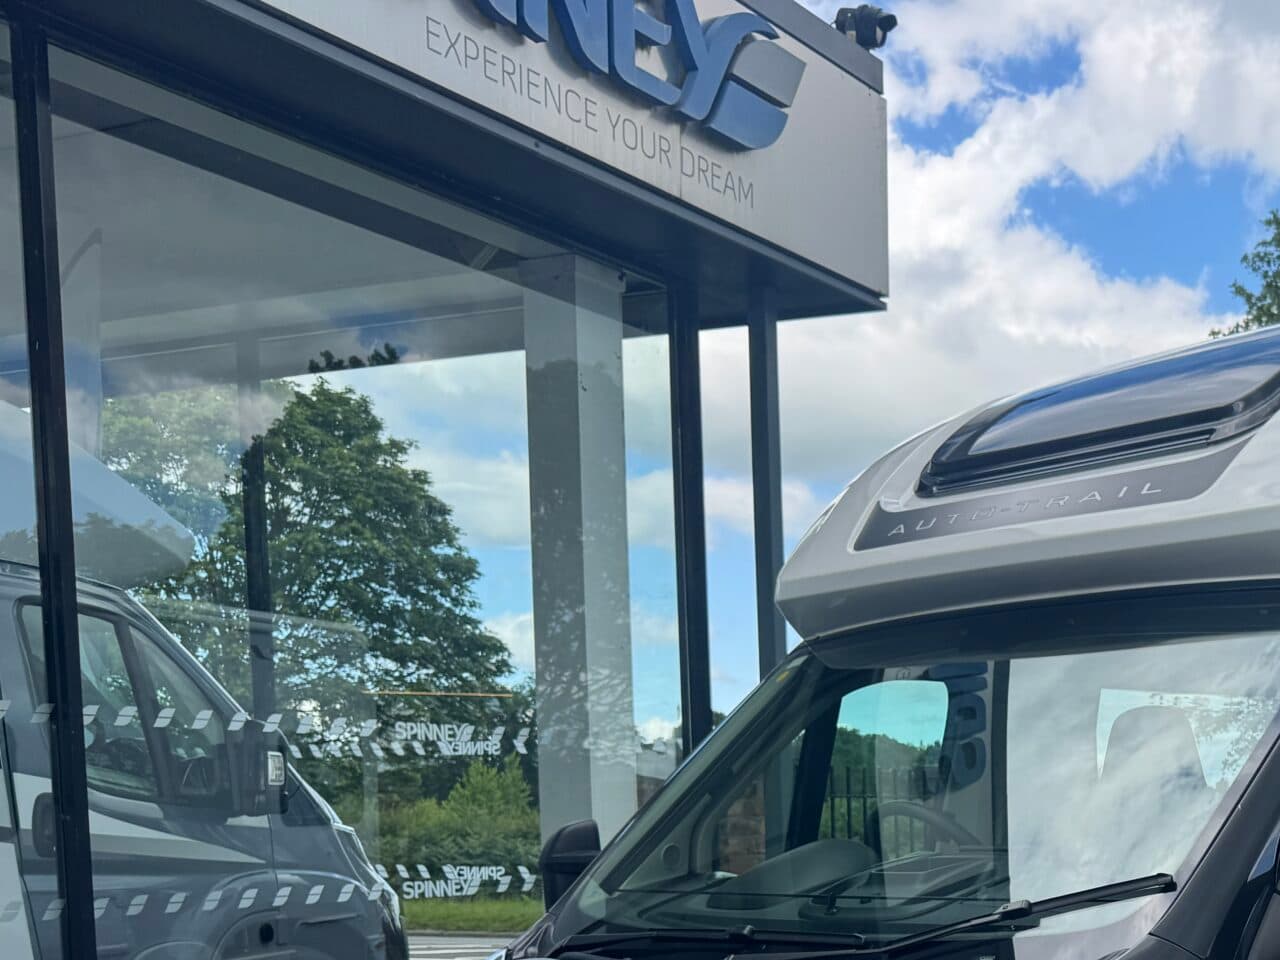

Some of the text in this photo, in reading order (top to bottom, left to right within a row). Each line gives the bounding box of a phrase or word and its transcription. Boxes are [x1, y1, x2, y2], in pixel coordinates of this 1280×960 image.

[425, 16, 755, 209] EXPERIENCE YOUR DREAM
[394, 721, 469, 741] SPINNEY
[402, 879, 471, 899] SPINNEY
